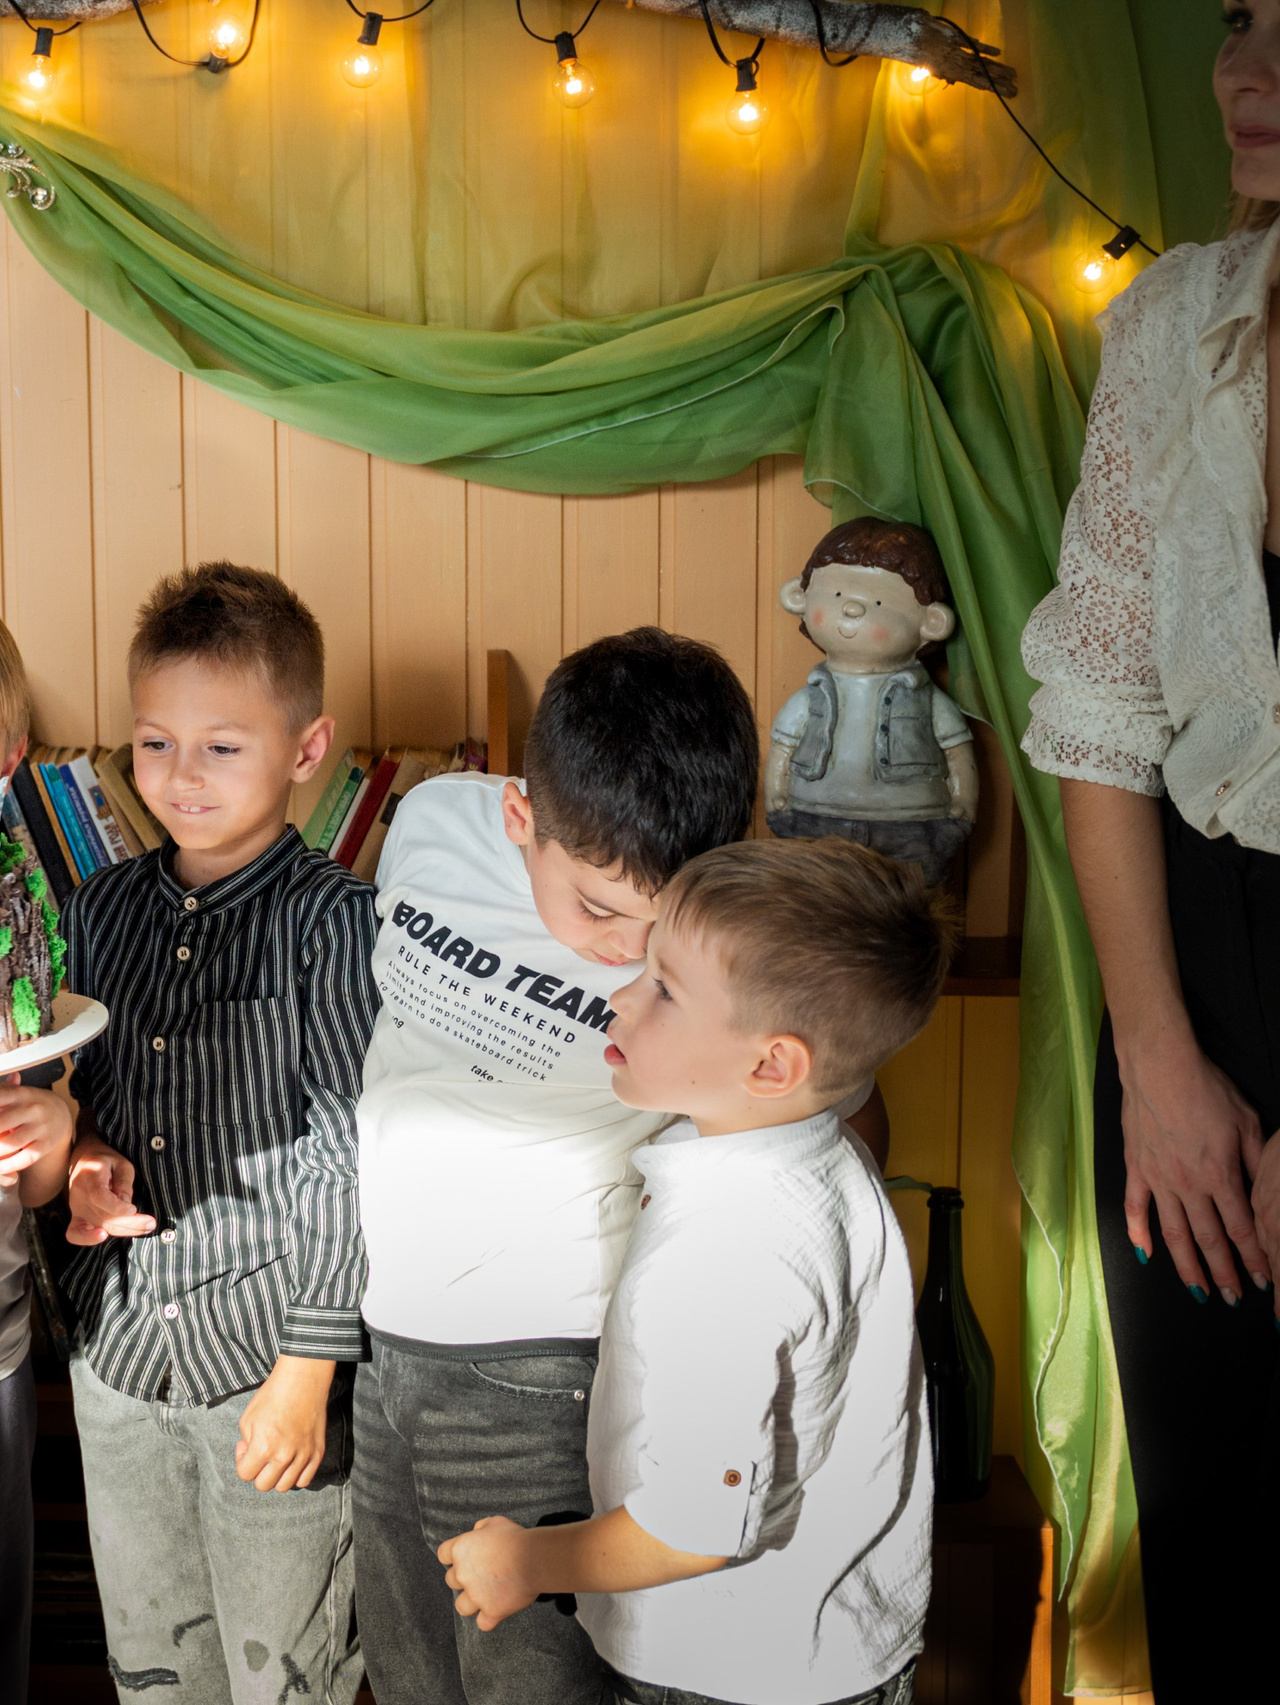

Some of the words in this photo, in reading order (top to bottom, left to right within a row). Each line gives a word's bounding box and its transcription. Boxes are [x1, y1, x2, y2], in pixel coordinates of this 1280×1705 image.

[388, 961, 415, 985] Always
[419, 984, 448, 1003] focus
[454, 1001, 467, 1011] on
[471, 1009, 536, 1046] overcoming
[541, 1043, 561, 1058] the
[392, 901, 501, 978] BOARD
[505, 964, 617, 1034] TEAM
[398, 945, 431, 975] RULE
[439, 974, 471, 996] THE
[484, 993, 575, 1043] WEEKEND
[379, 981, 388, 991] To
[390, 991, 413, 1011] learn
[416, 1009, 425, 1019] to
[430, 1017, 441, 1027] do
[453, 1030, 514, 1065] skateboard
[516, 1063, 547, 1081] trick
[386, 971, 406, 993] limits
[409, 992, 426, 1006] and
[431, 1003, 483, 1036] improving
[488, 1033, 506, 1046] the
[511, 1045, 554, 1070] results
[392, 1015, 404, 1028] ng
[471, 1065, 494, 1081] take
